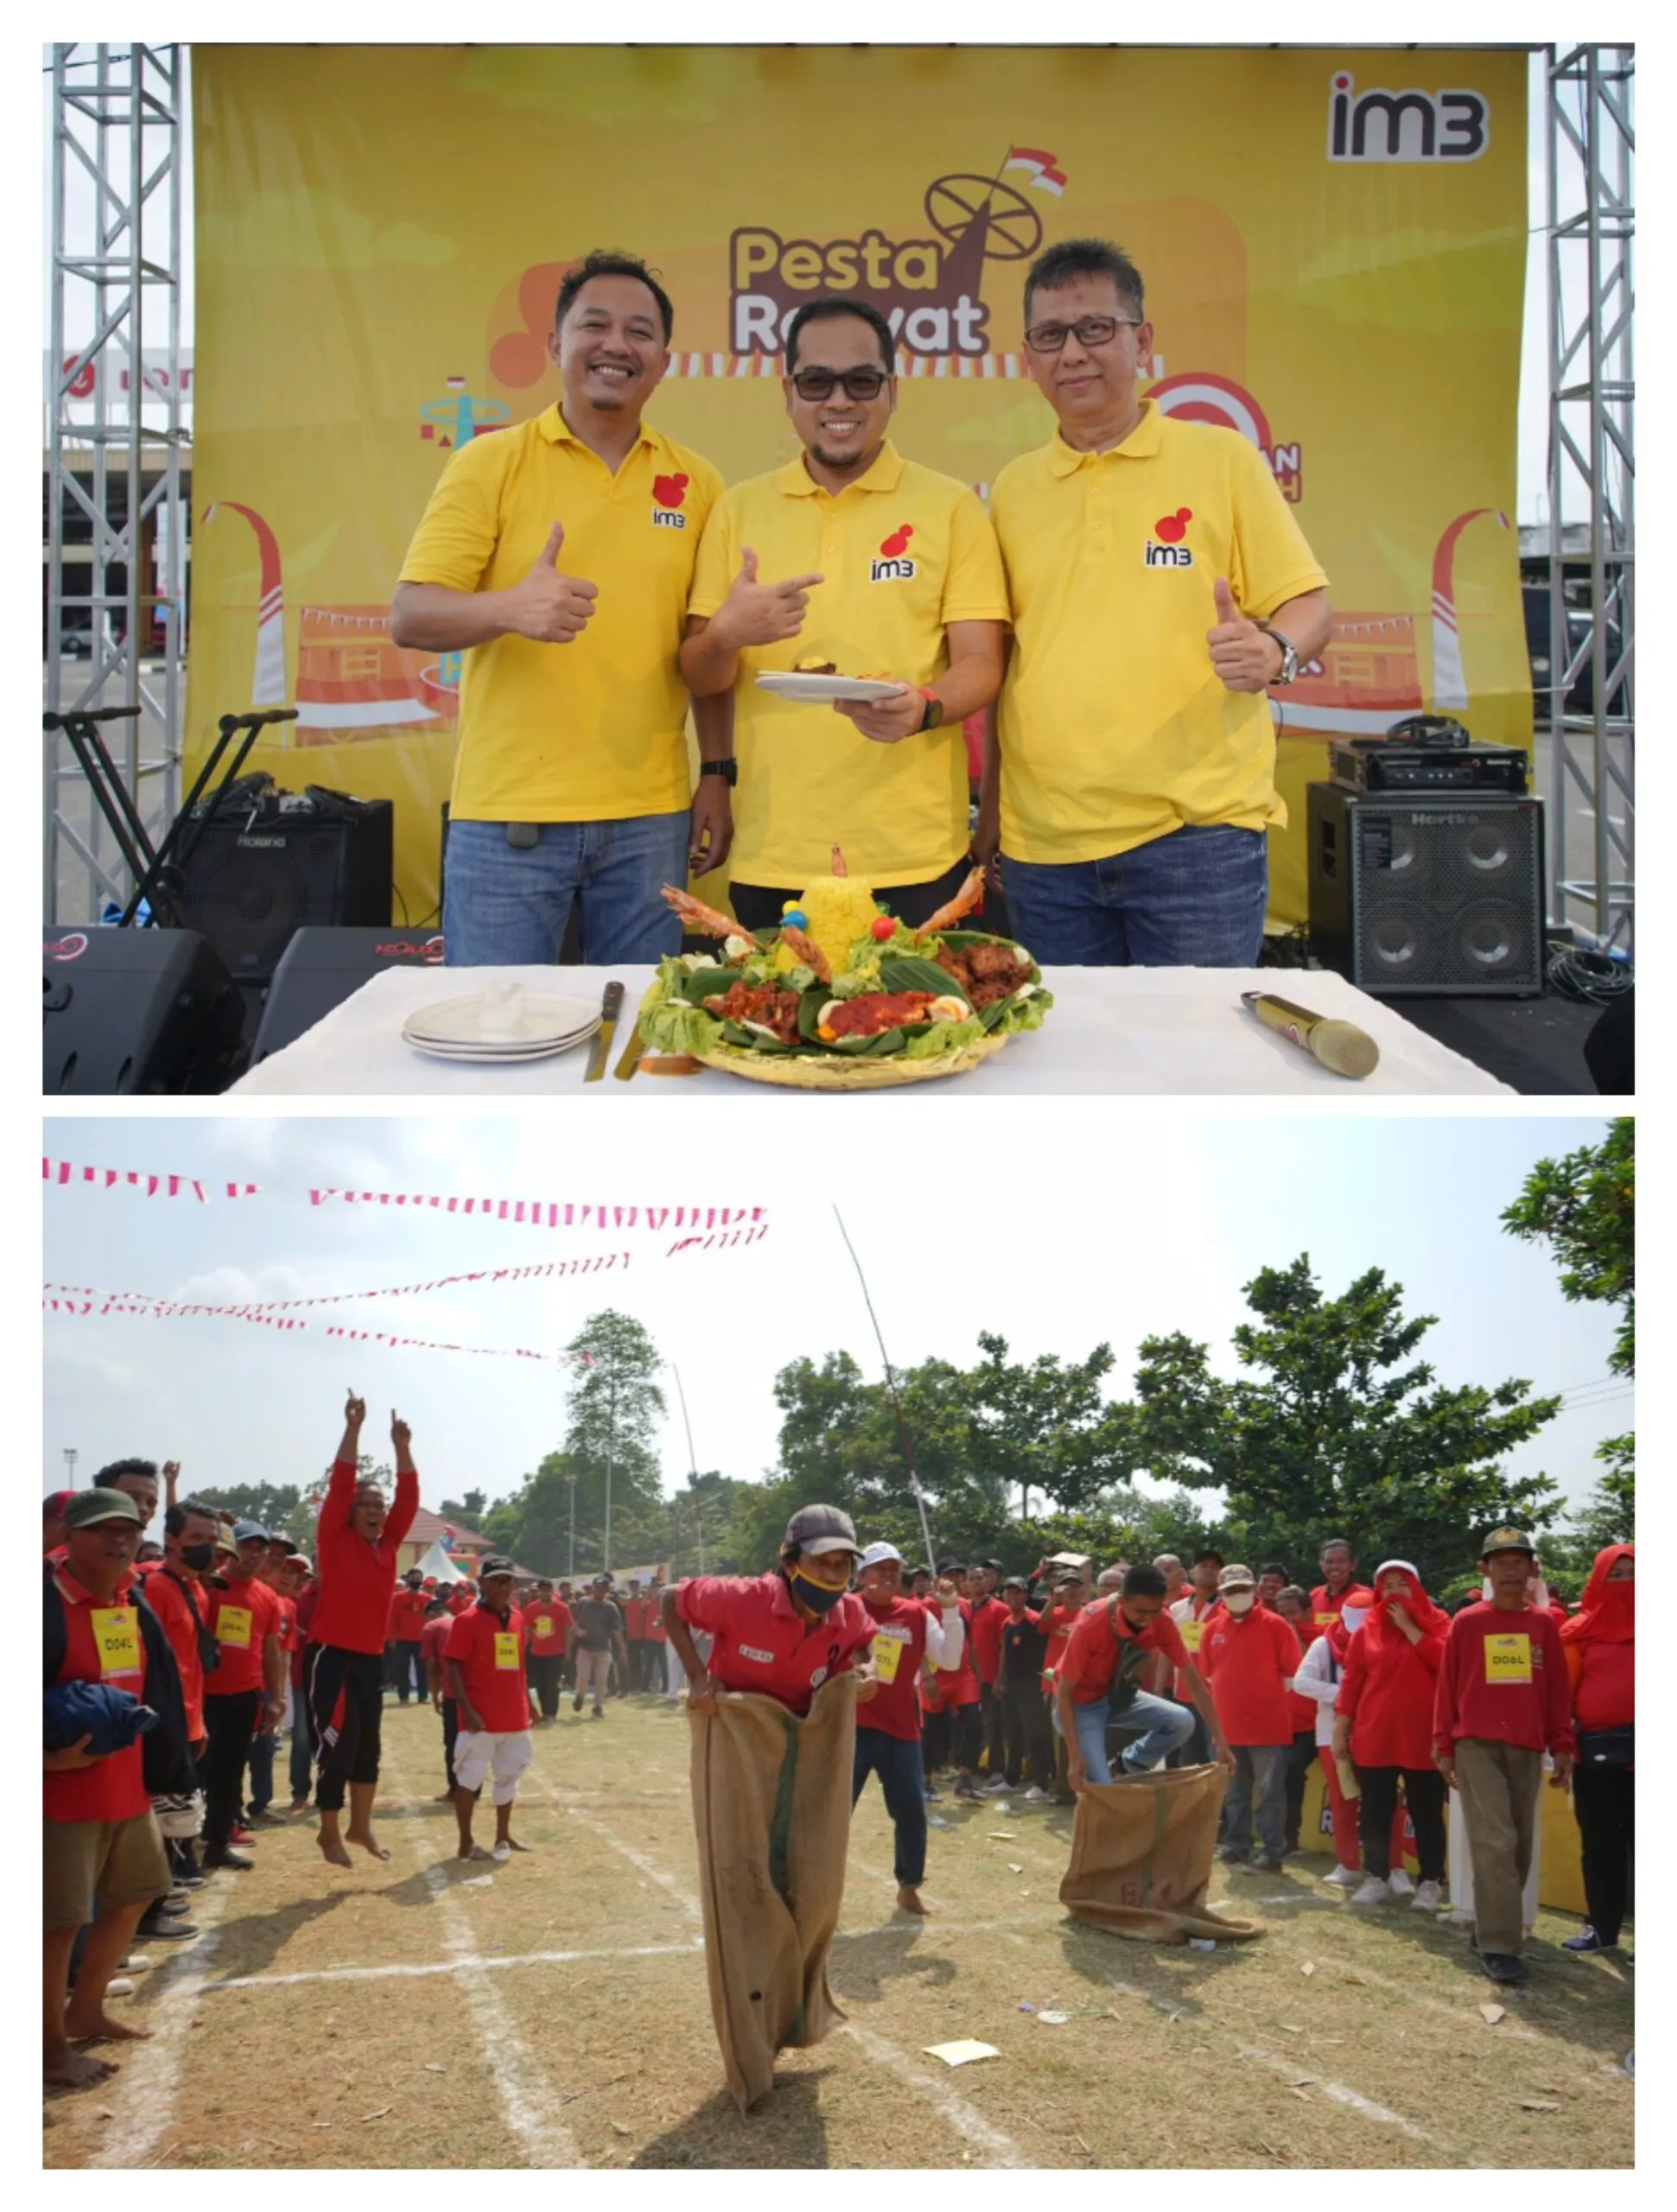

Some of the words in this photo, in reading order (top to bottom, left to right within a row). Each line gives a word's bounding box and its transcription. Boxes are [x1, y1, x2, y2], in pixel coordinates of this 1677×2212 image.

[1332, 75, 1484, 156] im3
[735, 235, 938, 291] Pesta
[653, 507, 685, 528] im3
[1146, 540, 1192, 565] im3
[871, 558, 914, 581] im3
